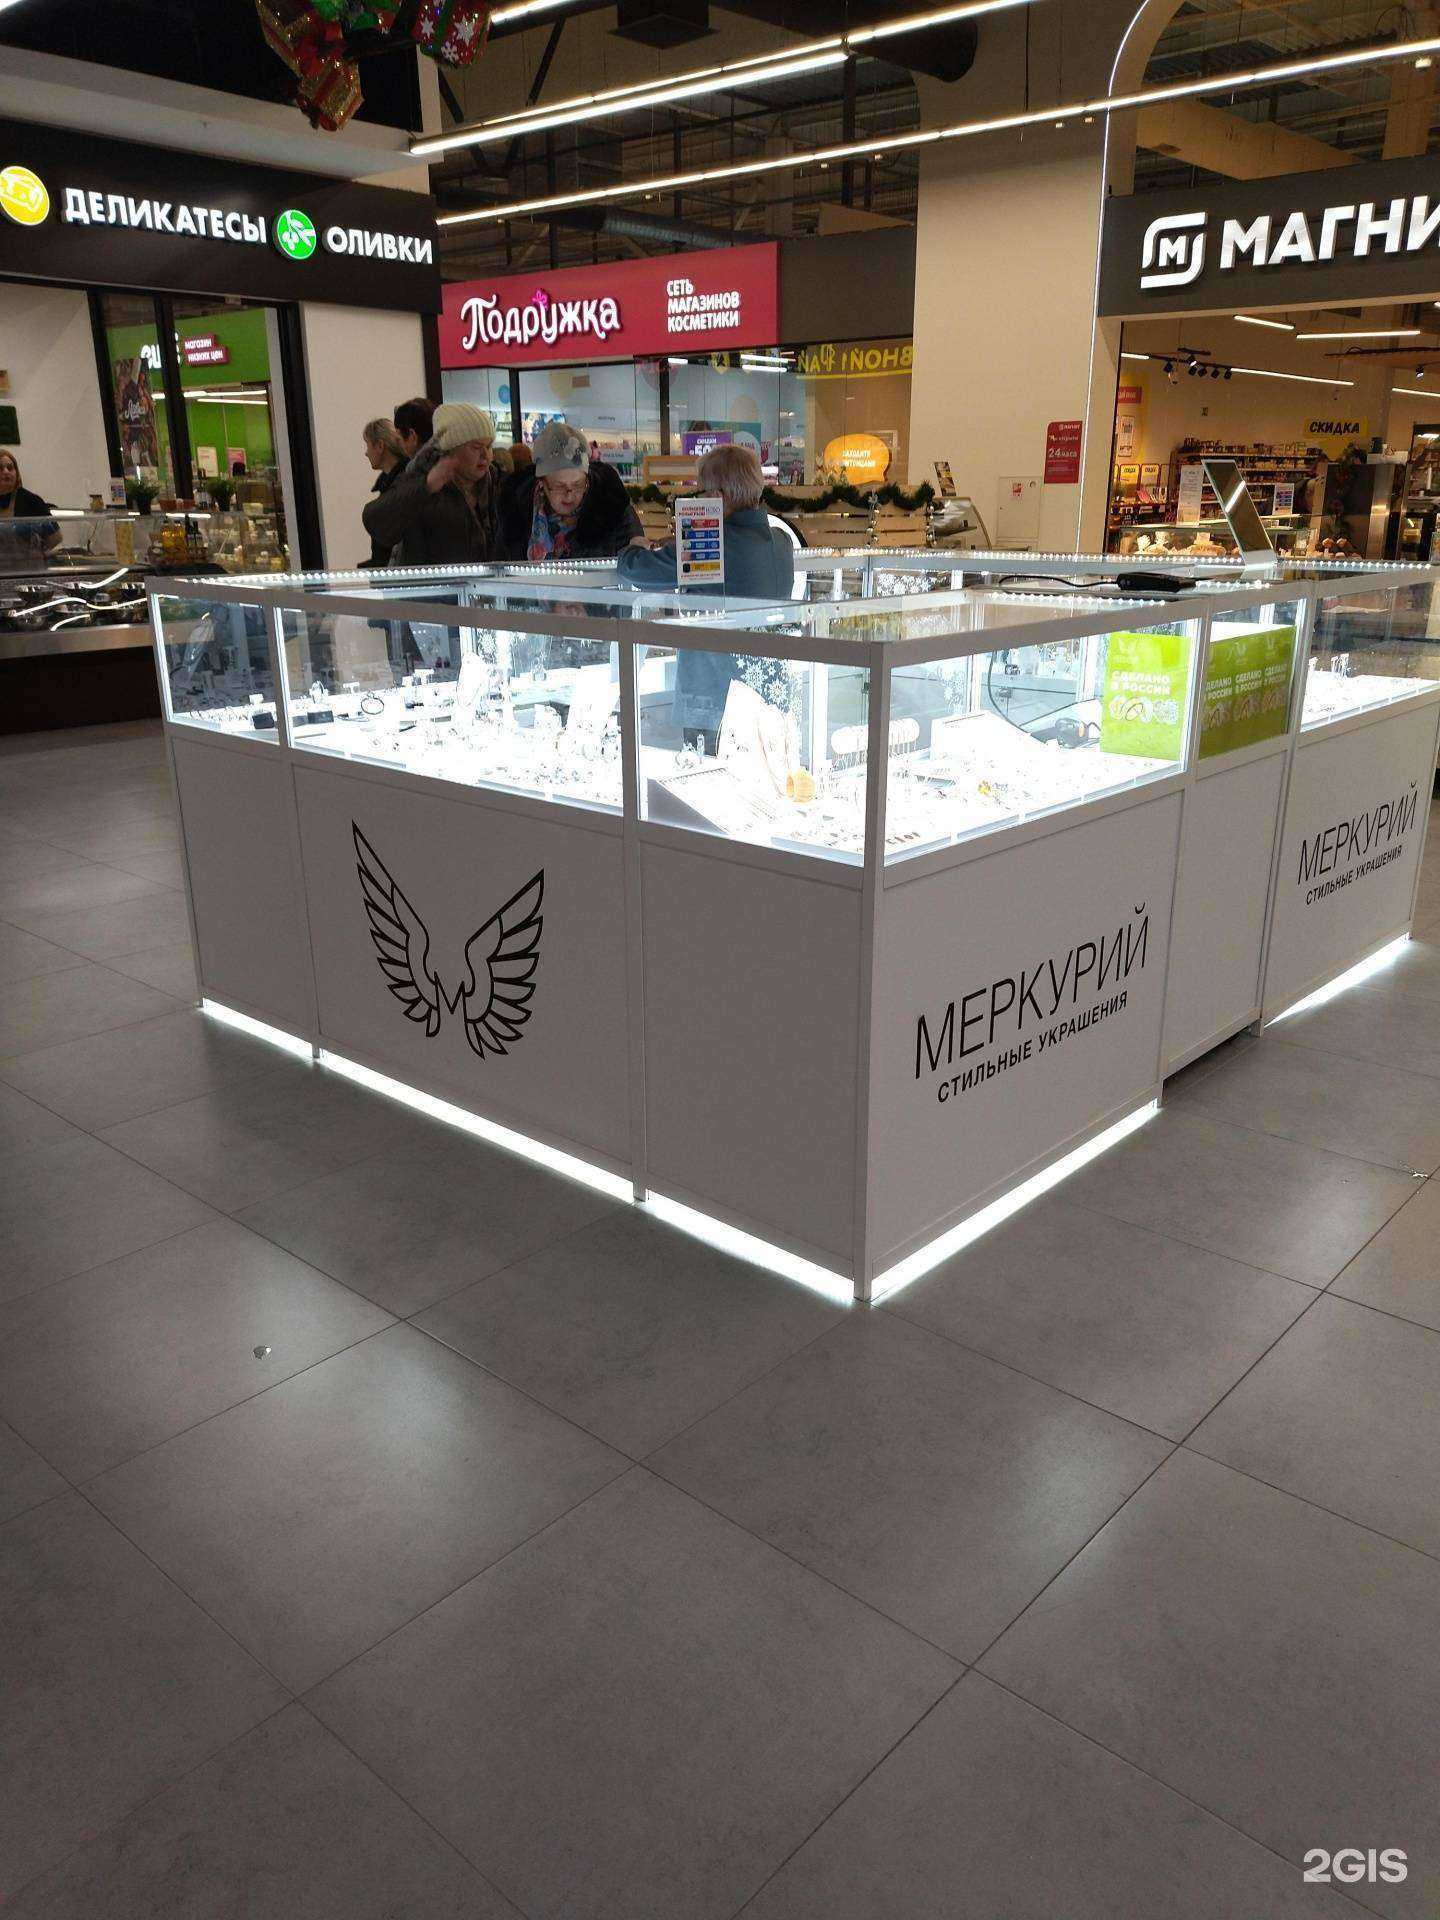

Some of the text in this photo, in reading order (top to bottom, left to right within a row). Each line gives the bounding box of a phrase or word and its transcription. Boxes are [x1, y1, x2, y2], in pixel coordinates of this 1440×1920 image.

[63, 188, 432, 264] ДЕЛИКАТЕСЫ ОЛИВКИ
[667, 278, 693, 297] СЕТЬ
[667, 291, 740, 315] МАГАЗИНОВ
[461, 291, 621, 350] Подружка
[667, 310, 740, 332] КОСМЕТИКИ
[1309, 421, 1360, 435] СКИДКА
[1112, 671, 1171, 683] СДЕЛАНО
[1122, 683, 1171, 695] РОССИИ
[1297, 780, 1417, 886] МЕРКУРИЙ
[1306, 845, 1402, 905] СТИЛЬНЫЕ УКРАШЕНИЯ
[915, 902, 1149, 1079] МЕРКУРИЙ
[937, 990, 1128, 1103] СТИЛЬНЫЕ УКРАШЕНИЯ
